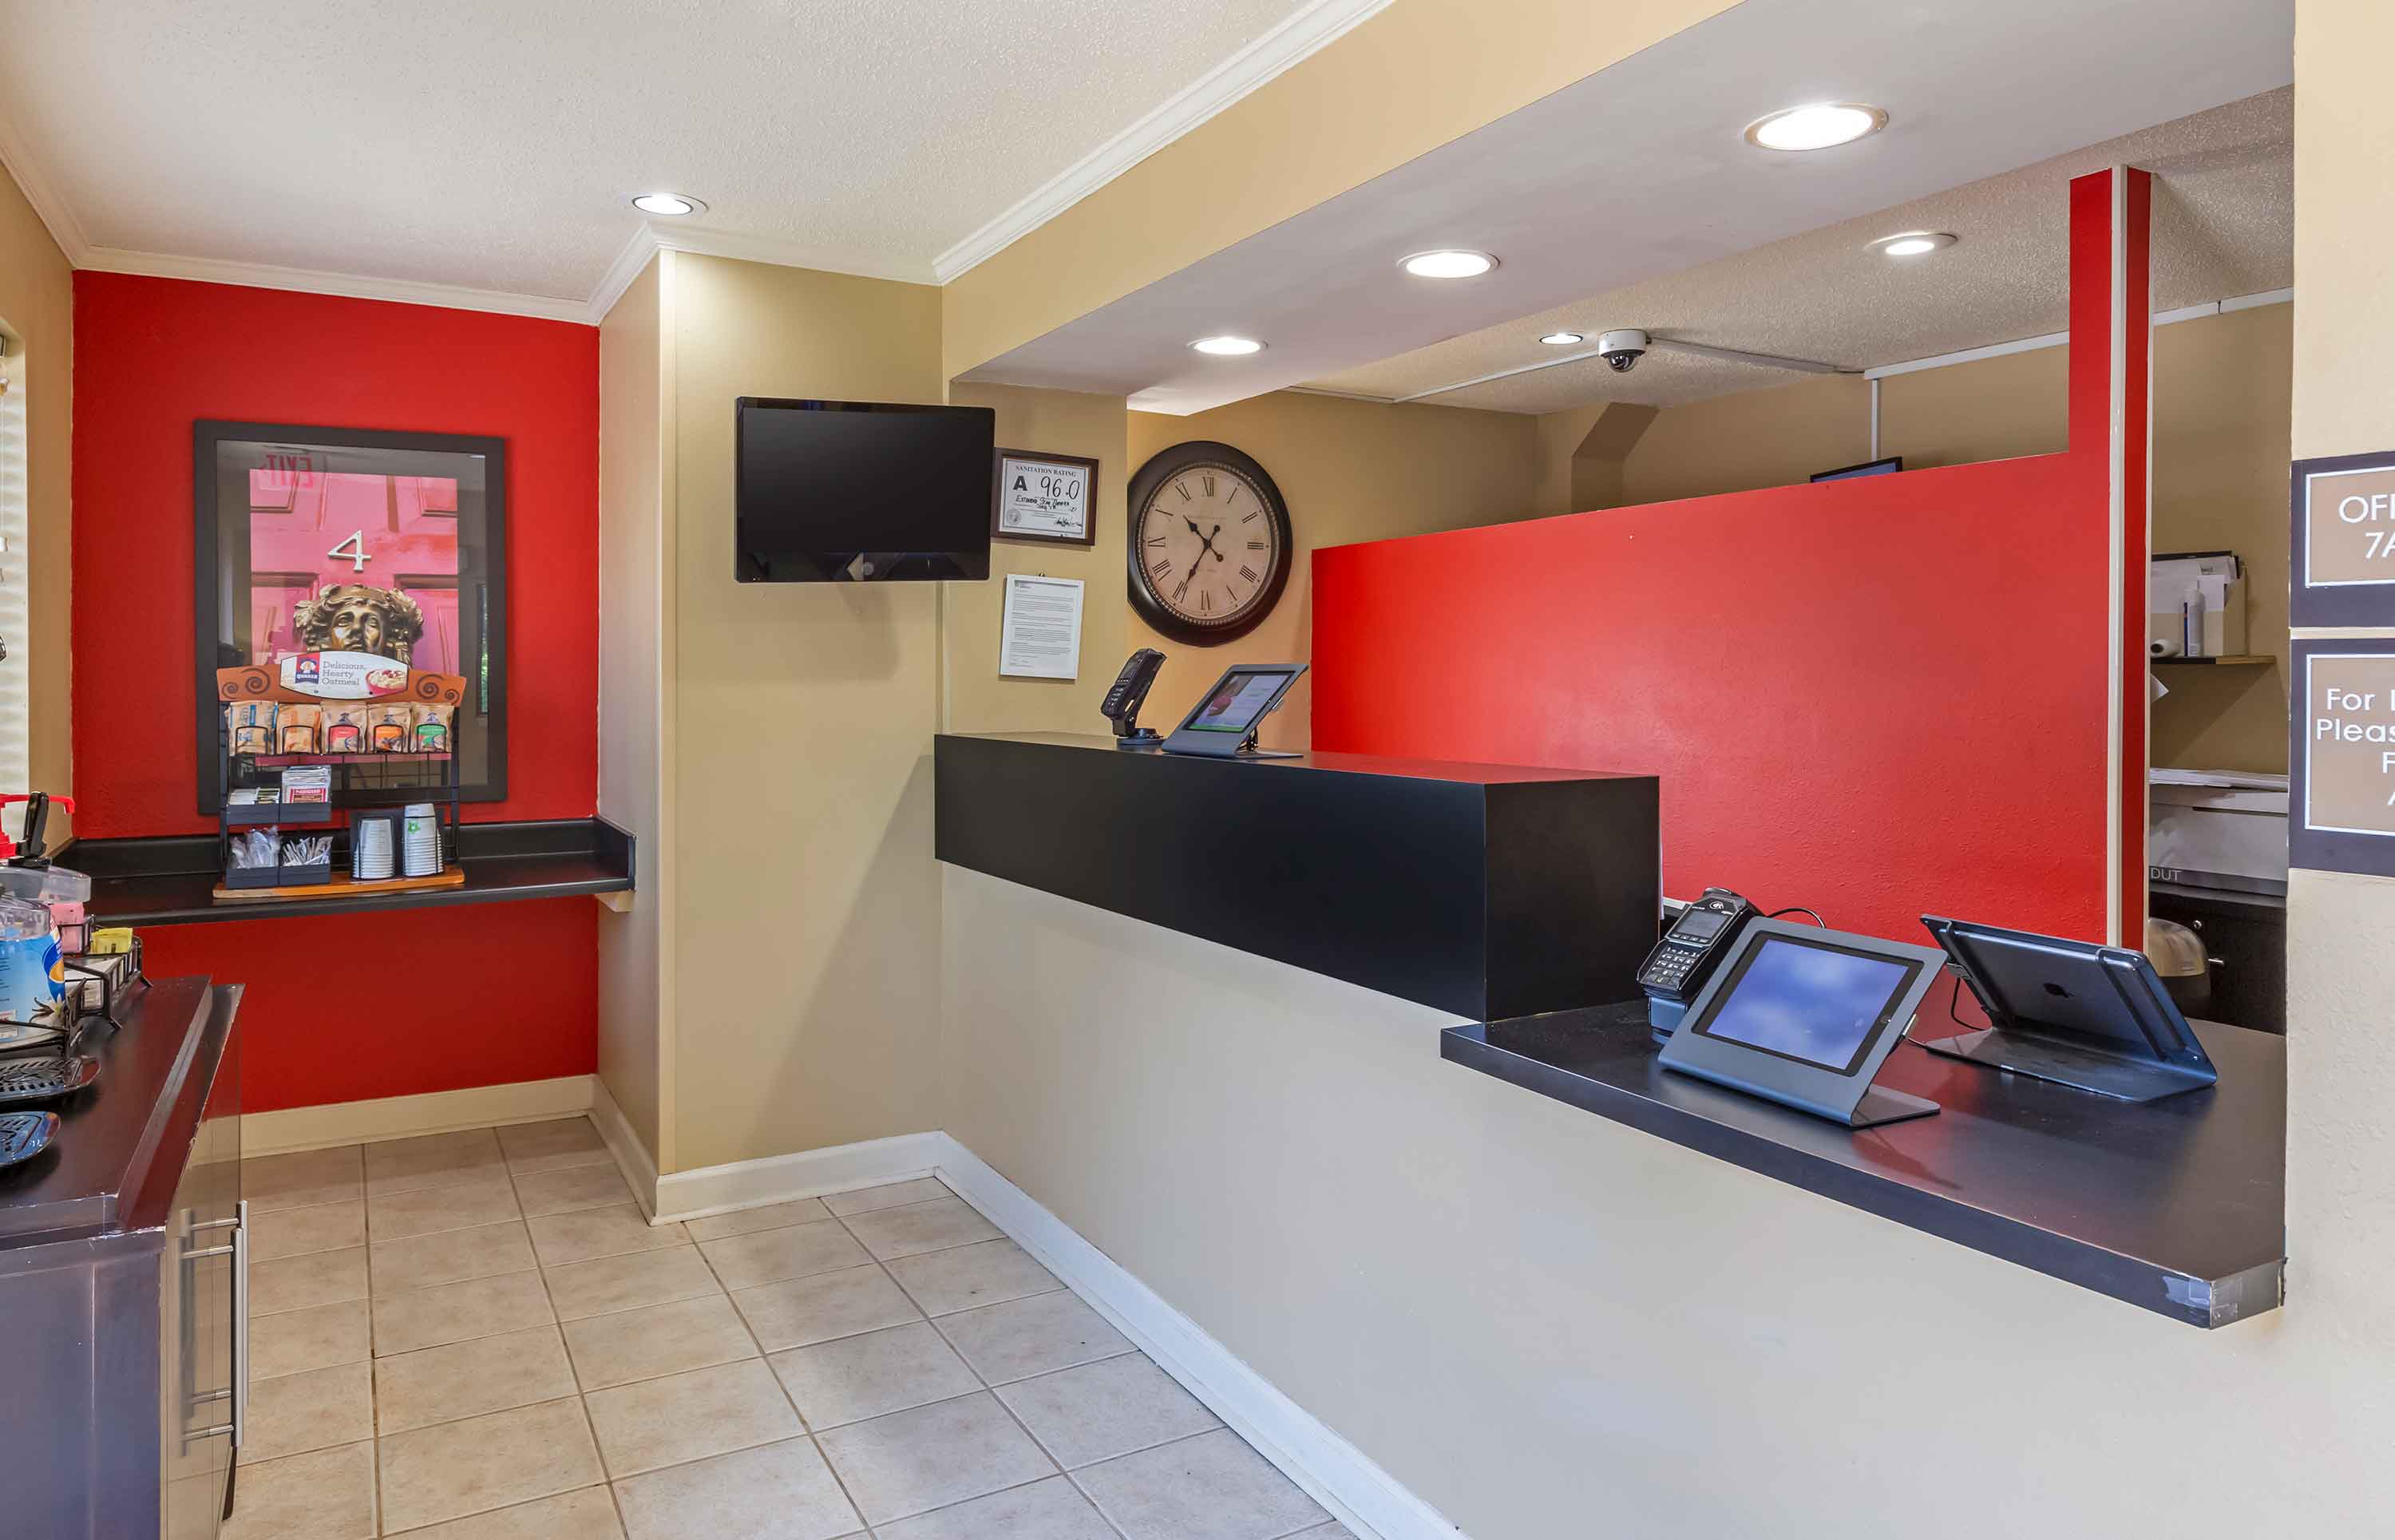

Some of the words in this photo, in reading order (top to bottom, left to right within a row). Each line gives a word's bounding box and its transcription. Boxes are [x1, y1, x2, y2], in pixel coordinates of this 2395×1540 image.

[1015, 465, 1052, 474] SANITATION
[1012, 475, 1027, 491] A
[1040, 476, 1080, 499] 96.0
[327, 529, 372, 572] 4
[322, 669, 353, 679] Hearty
[323, 661, 366, 671] Delicious,
[2327, 688, 2376, 711] For
